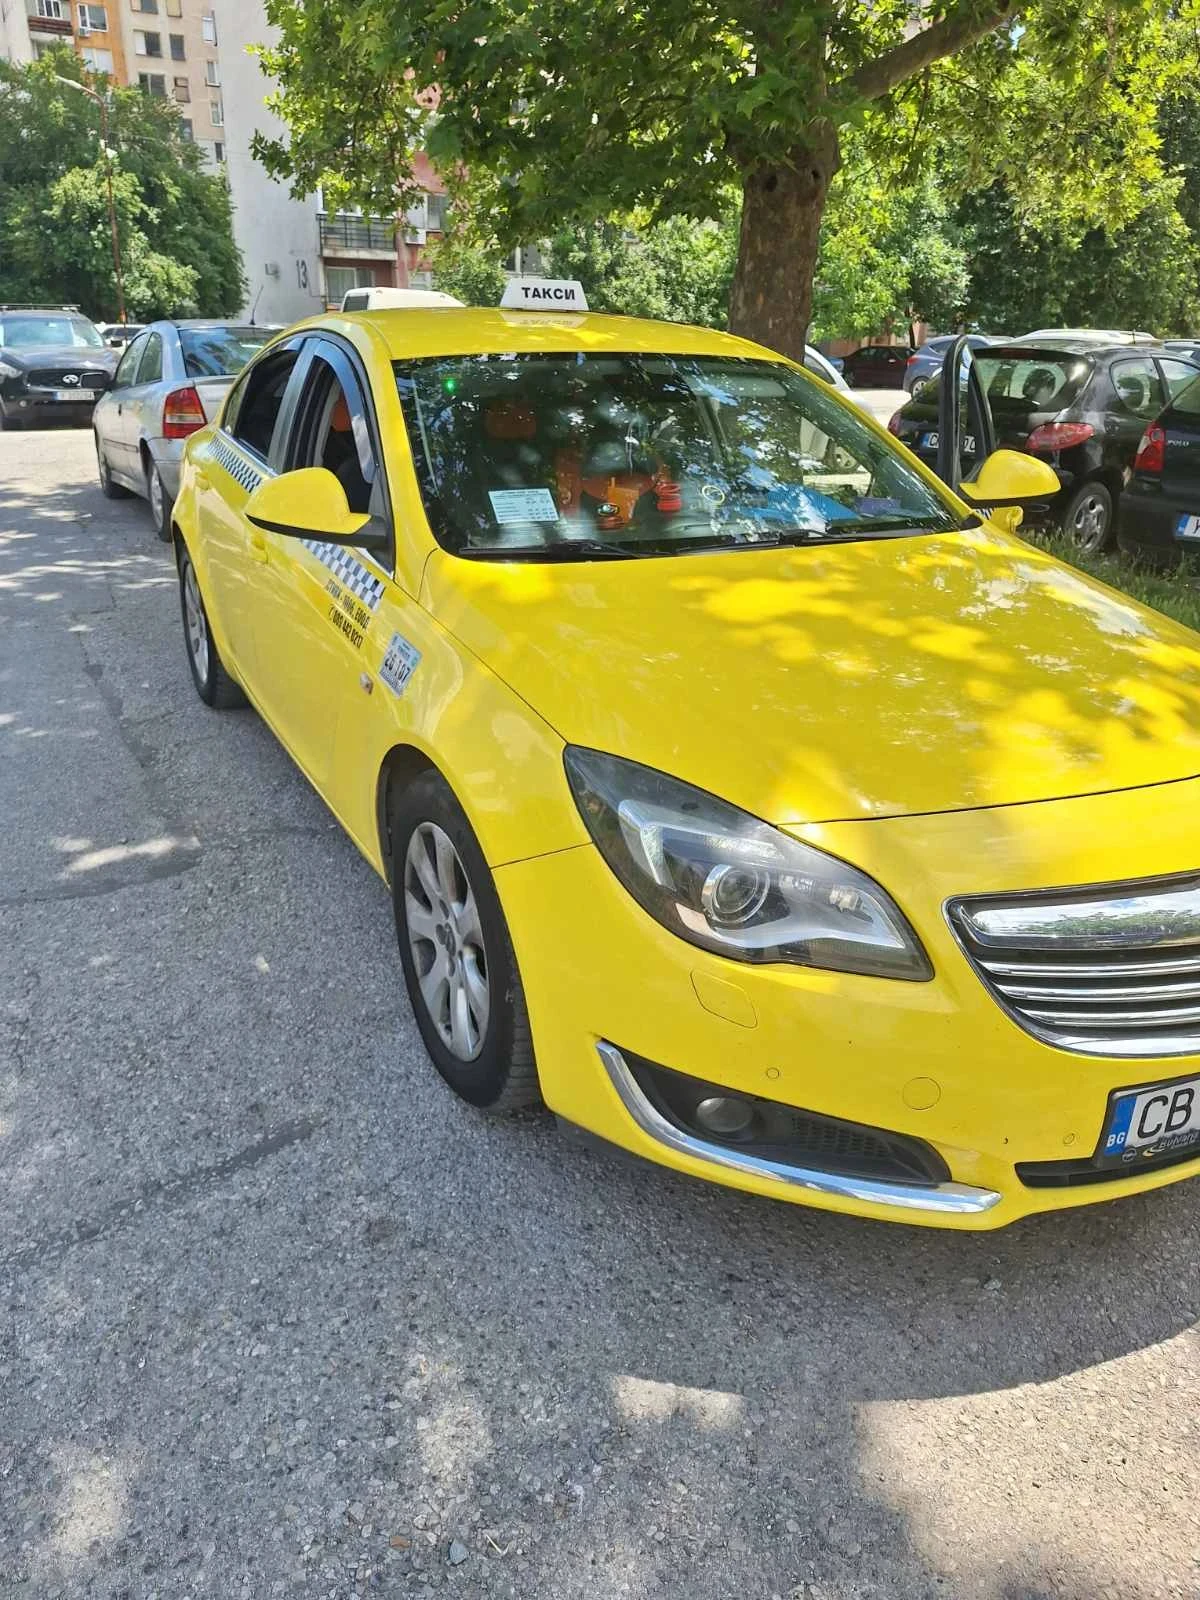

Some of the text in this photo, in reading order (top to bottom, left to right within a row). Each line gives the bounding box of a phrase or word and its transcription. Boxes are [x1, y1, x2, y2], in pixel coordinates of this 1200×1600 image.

[296, 260, 308, 289] 13
[521, 287, 575, 300] ТАКСИ
[1106, 1131, 1126, 1148] BG
